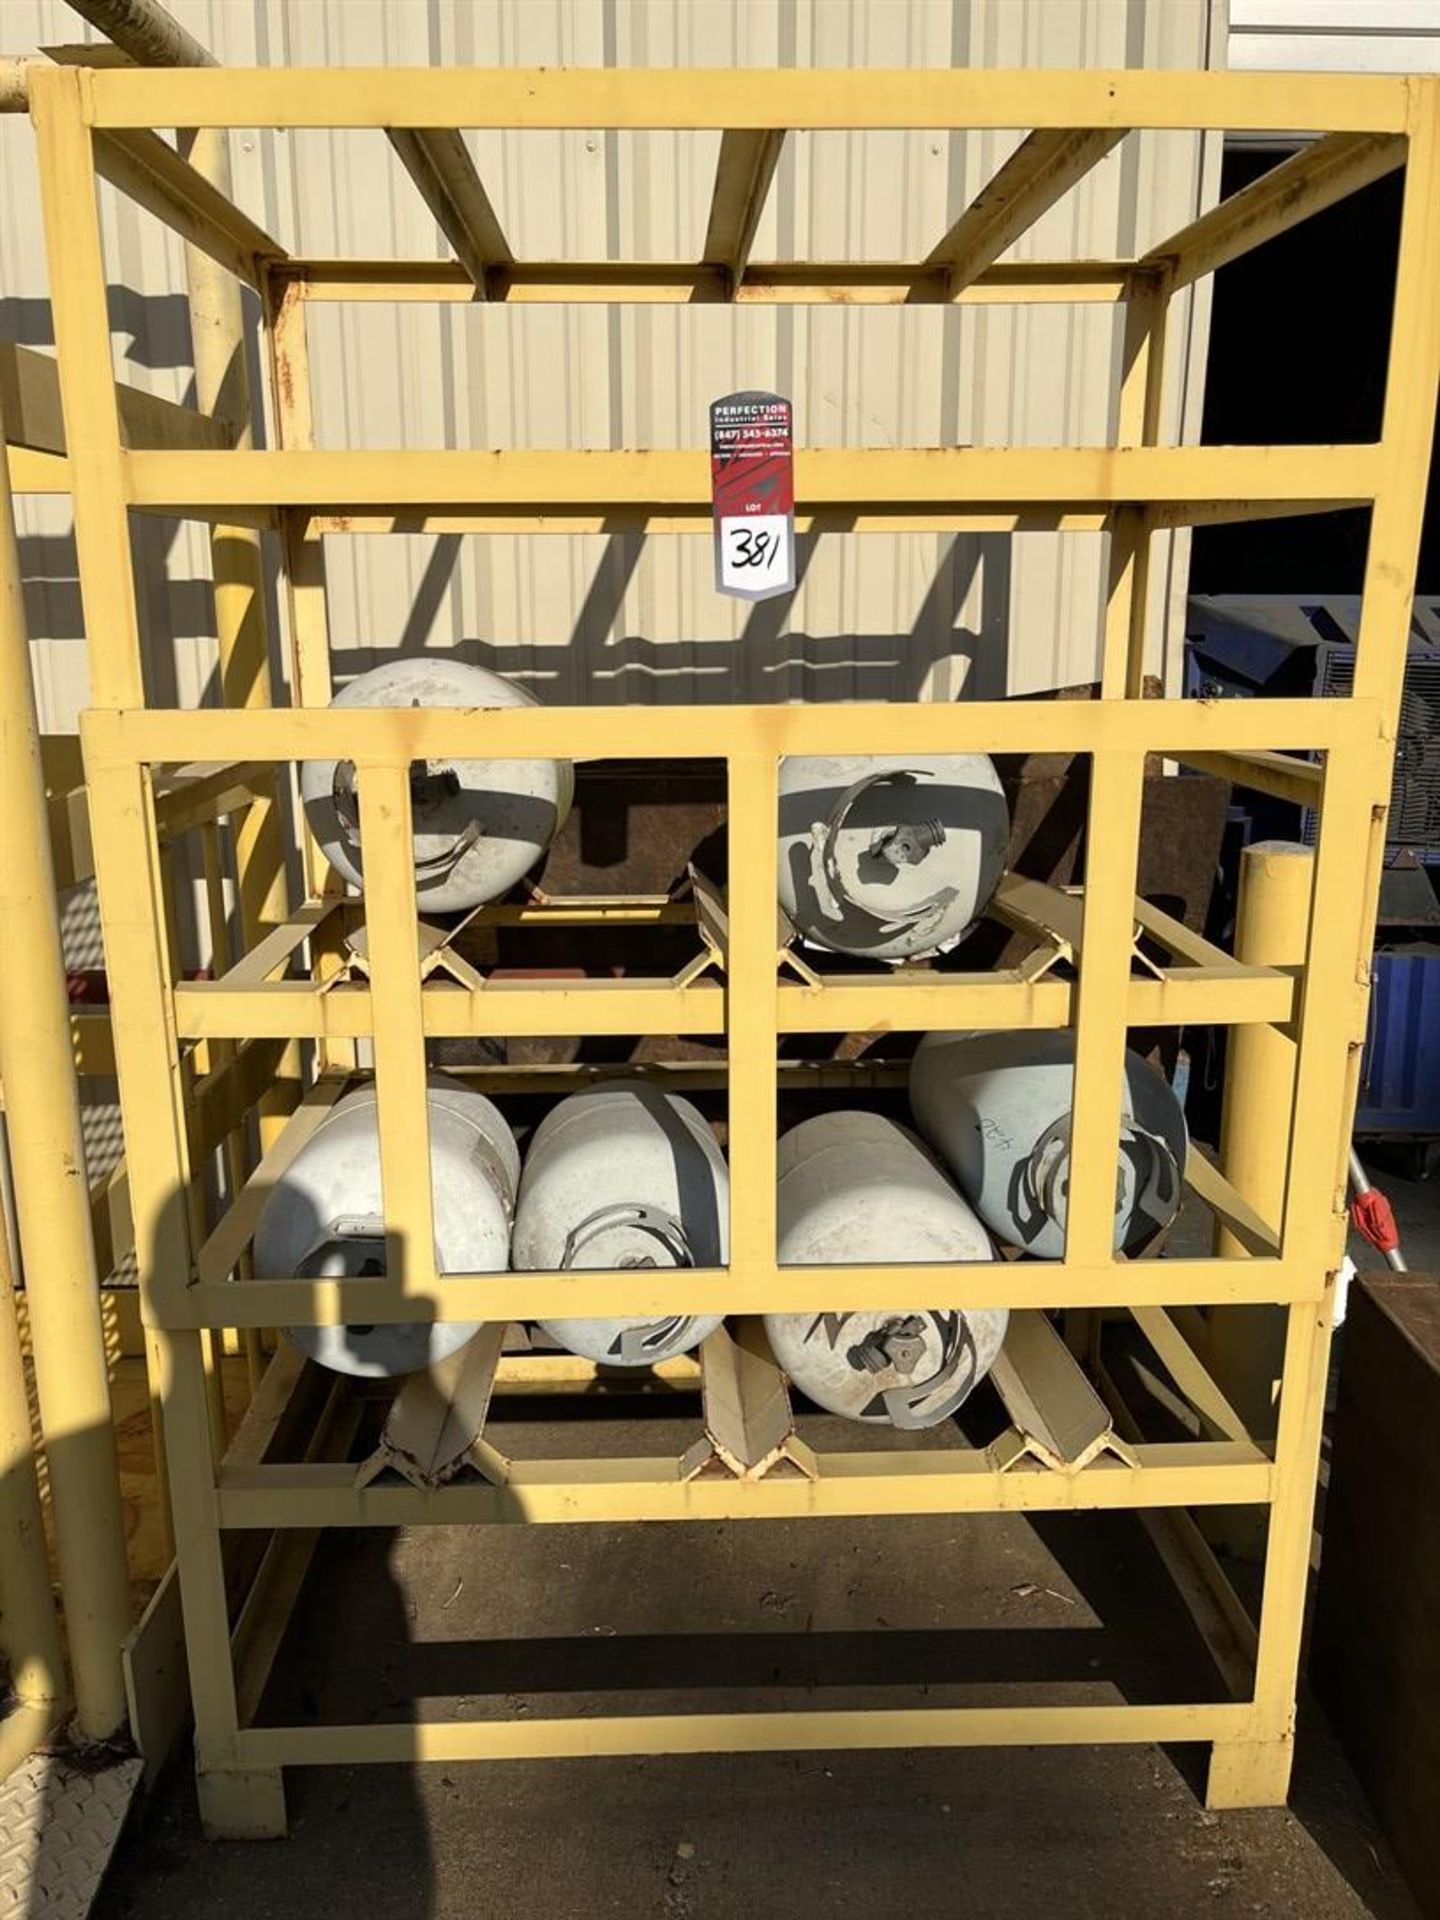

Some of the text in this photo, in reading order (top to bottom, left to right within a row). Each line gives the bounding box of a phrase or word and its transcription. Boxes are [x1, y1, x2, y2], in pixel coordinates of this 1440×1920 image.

[715, 404, 787, 416] PERFECTION
[746, 503, 762, 512] LOT
[730, 528, 780, 570] 381
